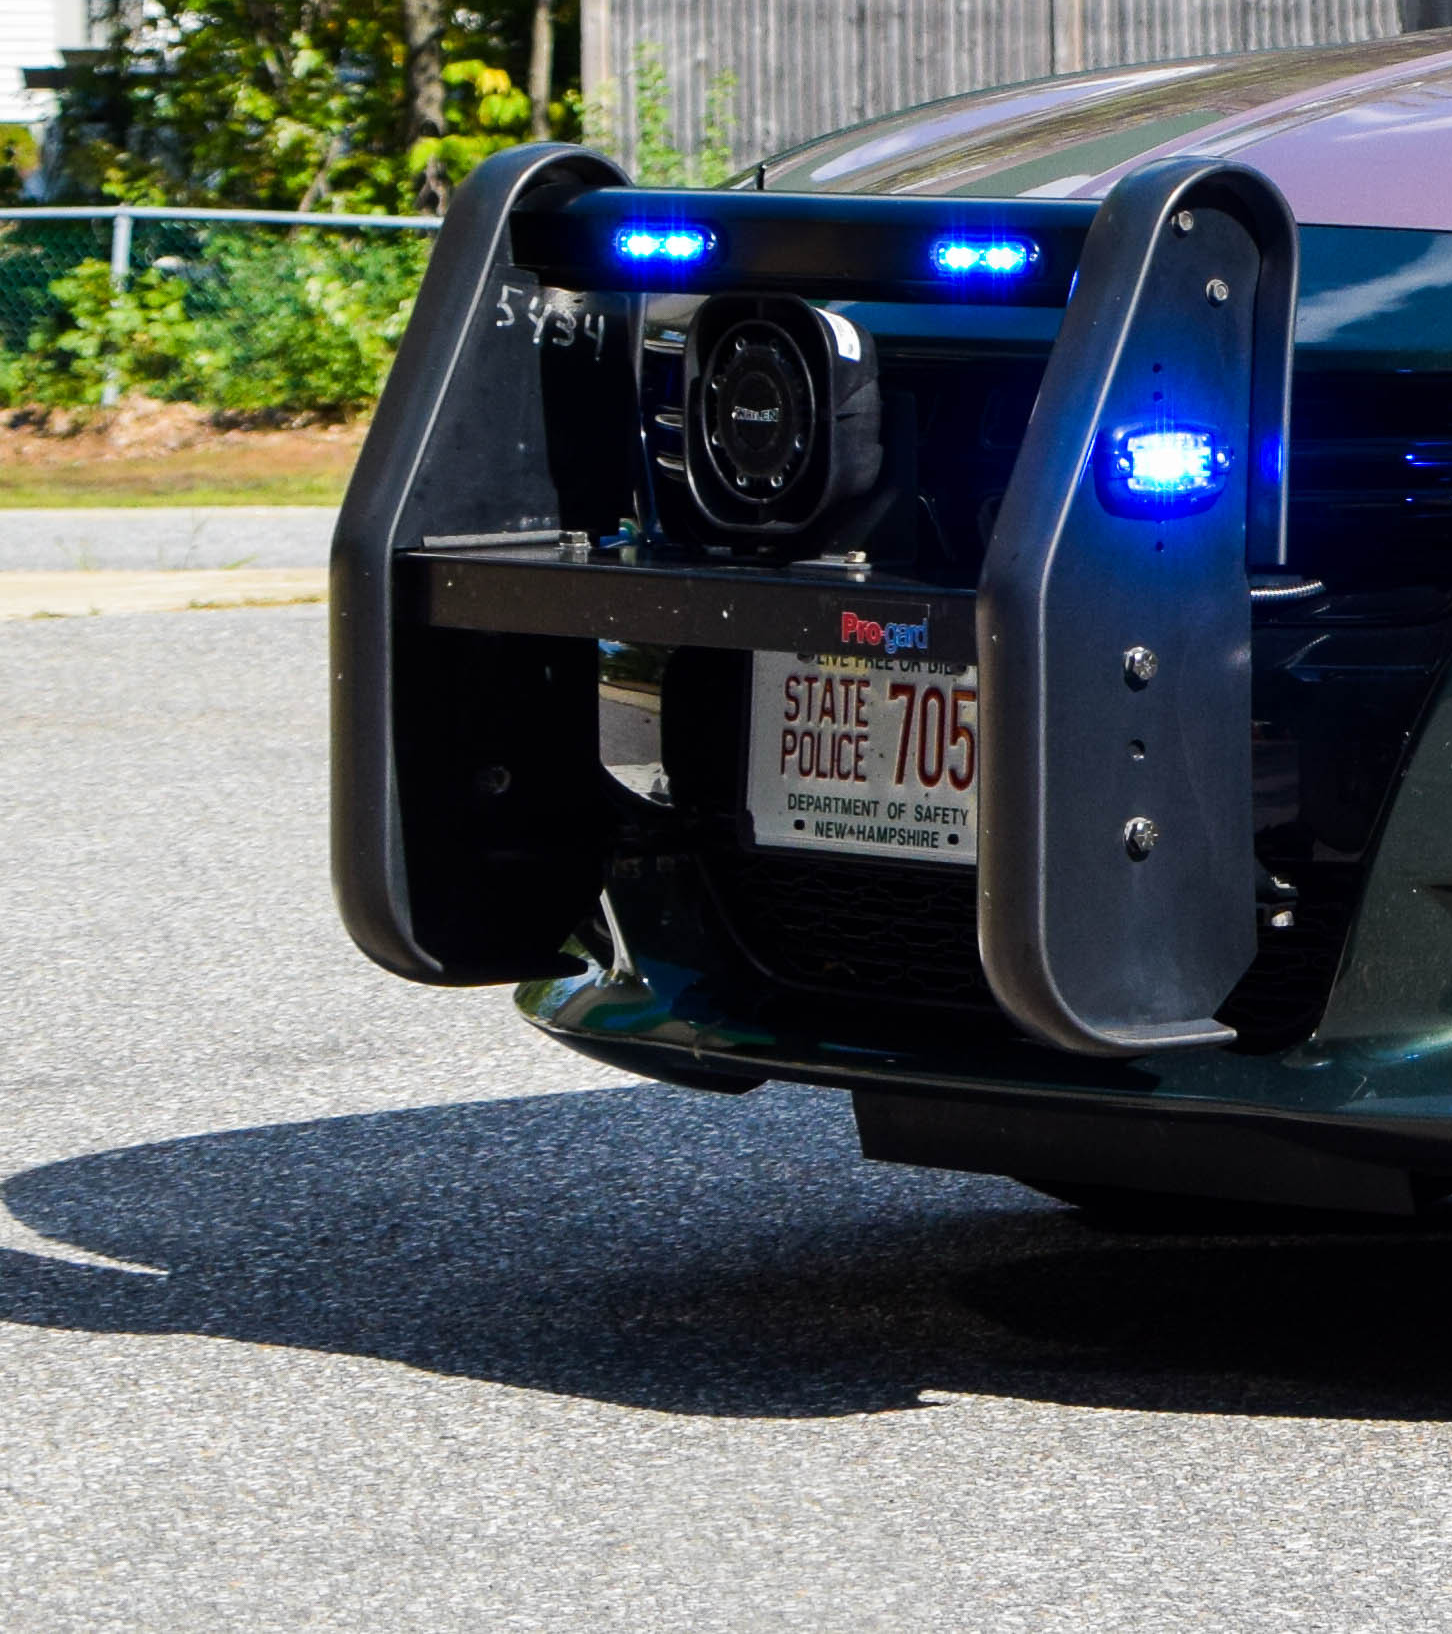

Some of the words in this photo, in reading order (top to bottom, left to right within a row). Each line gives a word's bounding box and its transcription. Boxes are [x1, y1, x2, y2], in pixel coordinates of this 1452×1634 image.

[841, 611, 929, 655] Pro-gard
[784, 675, 871, 728] STATE
[780, 729, 868, 782] POLICE
[888, 684, 977, 791] 705
[787, 793, 880, 818] DEPARTMENT
[887, 802, 906, 820] OF
[914, 804, 969, 826] SAFETY
[814, 820, 847, 839] NEW
[856, 826, 940, 849] HAMPSHIRE
